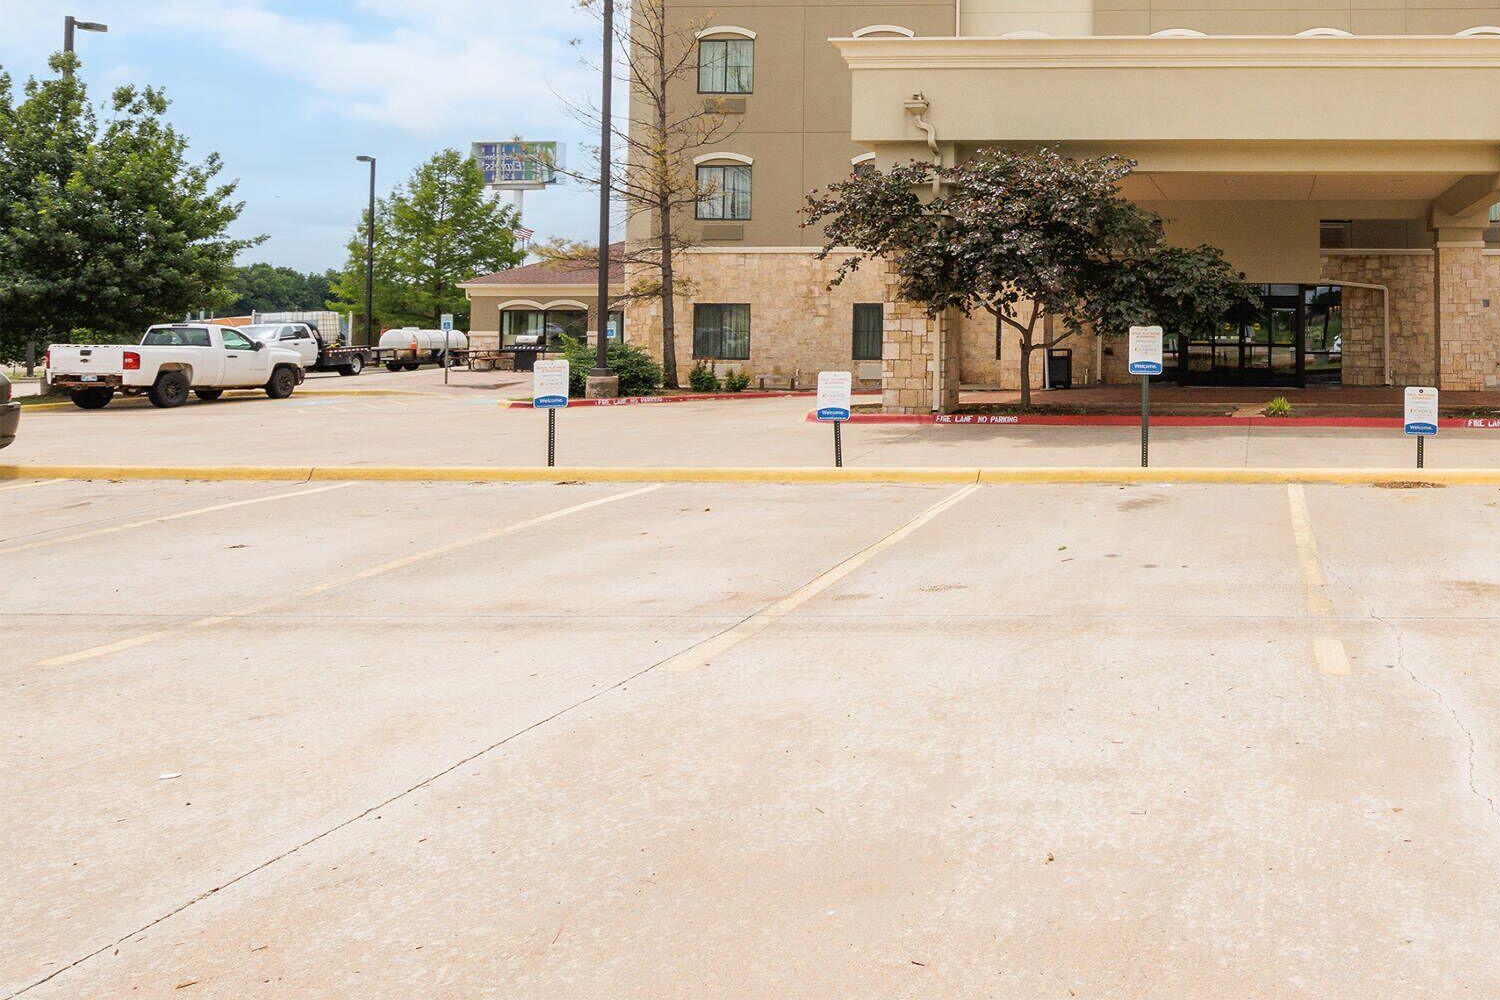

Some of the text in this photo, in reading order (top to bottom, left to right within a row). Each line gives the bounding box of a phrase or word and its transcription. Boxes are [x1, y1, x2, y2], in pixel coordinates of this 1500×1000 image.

[935, 415, 1018, 424] FIRE LANE NO PARKING
[1468, 419, 1484, 427] FIRE
